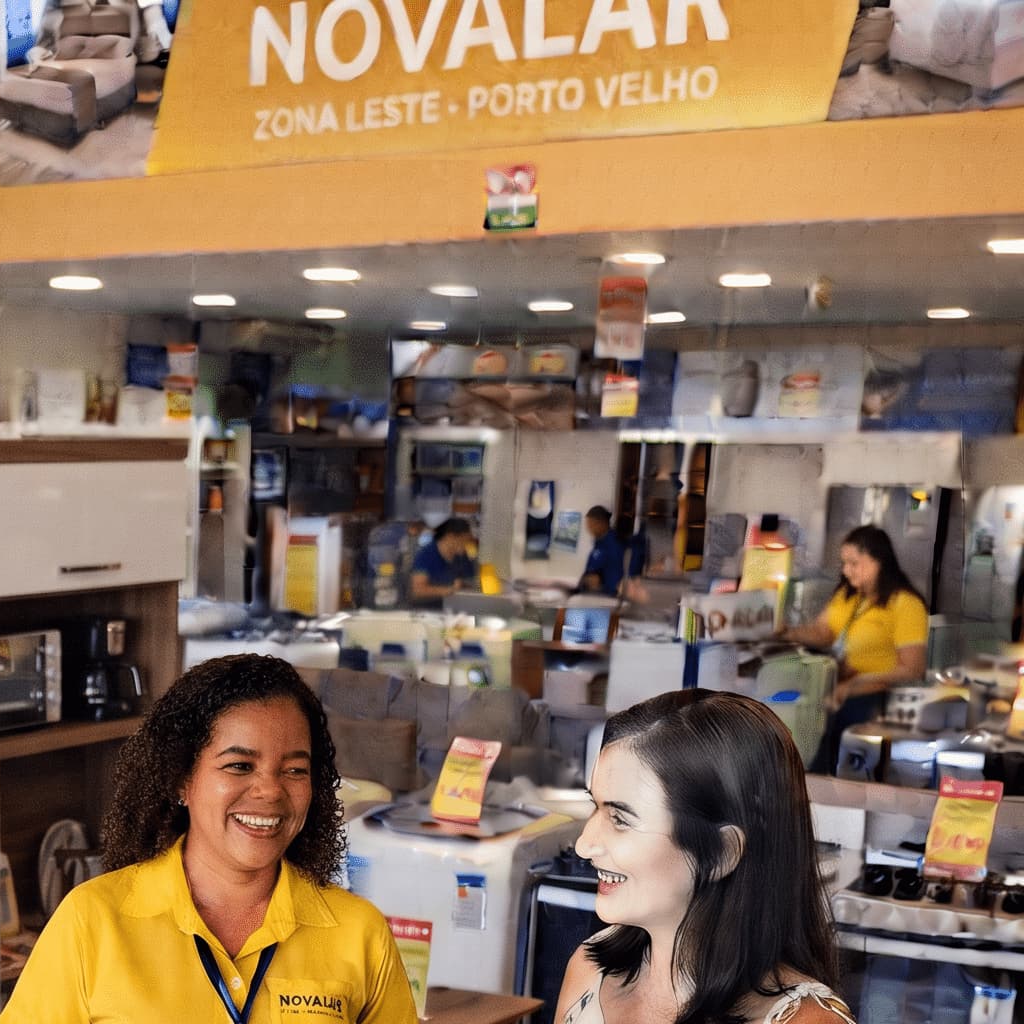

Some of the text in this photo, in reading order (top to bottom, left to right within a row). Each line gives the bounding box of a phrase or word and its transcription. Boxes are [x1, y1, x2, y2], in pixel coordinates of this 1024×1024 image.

[253, 66, 718, 141] ZONA LESTE PORTO VELHO
